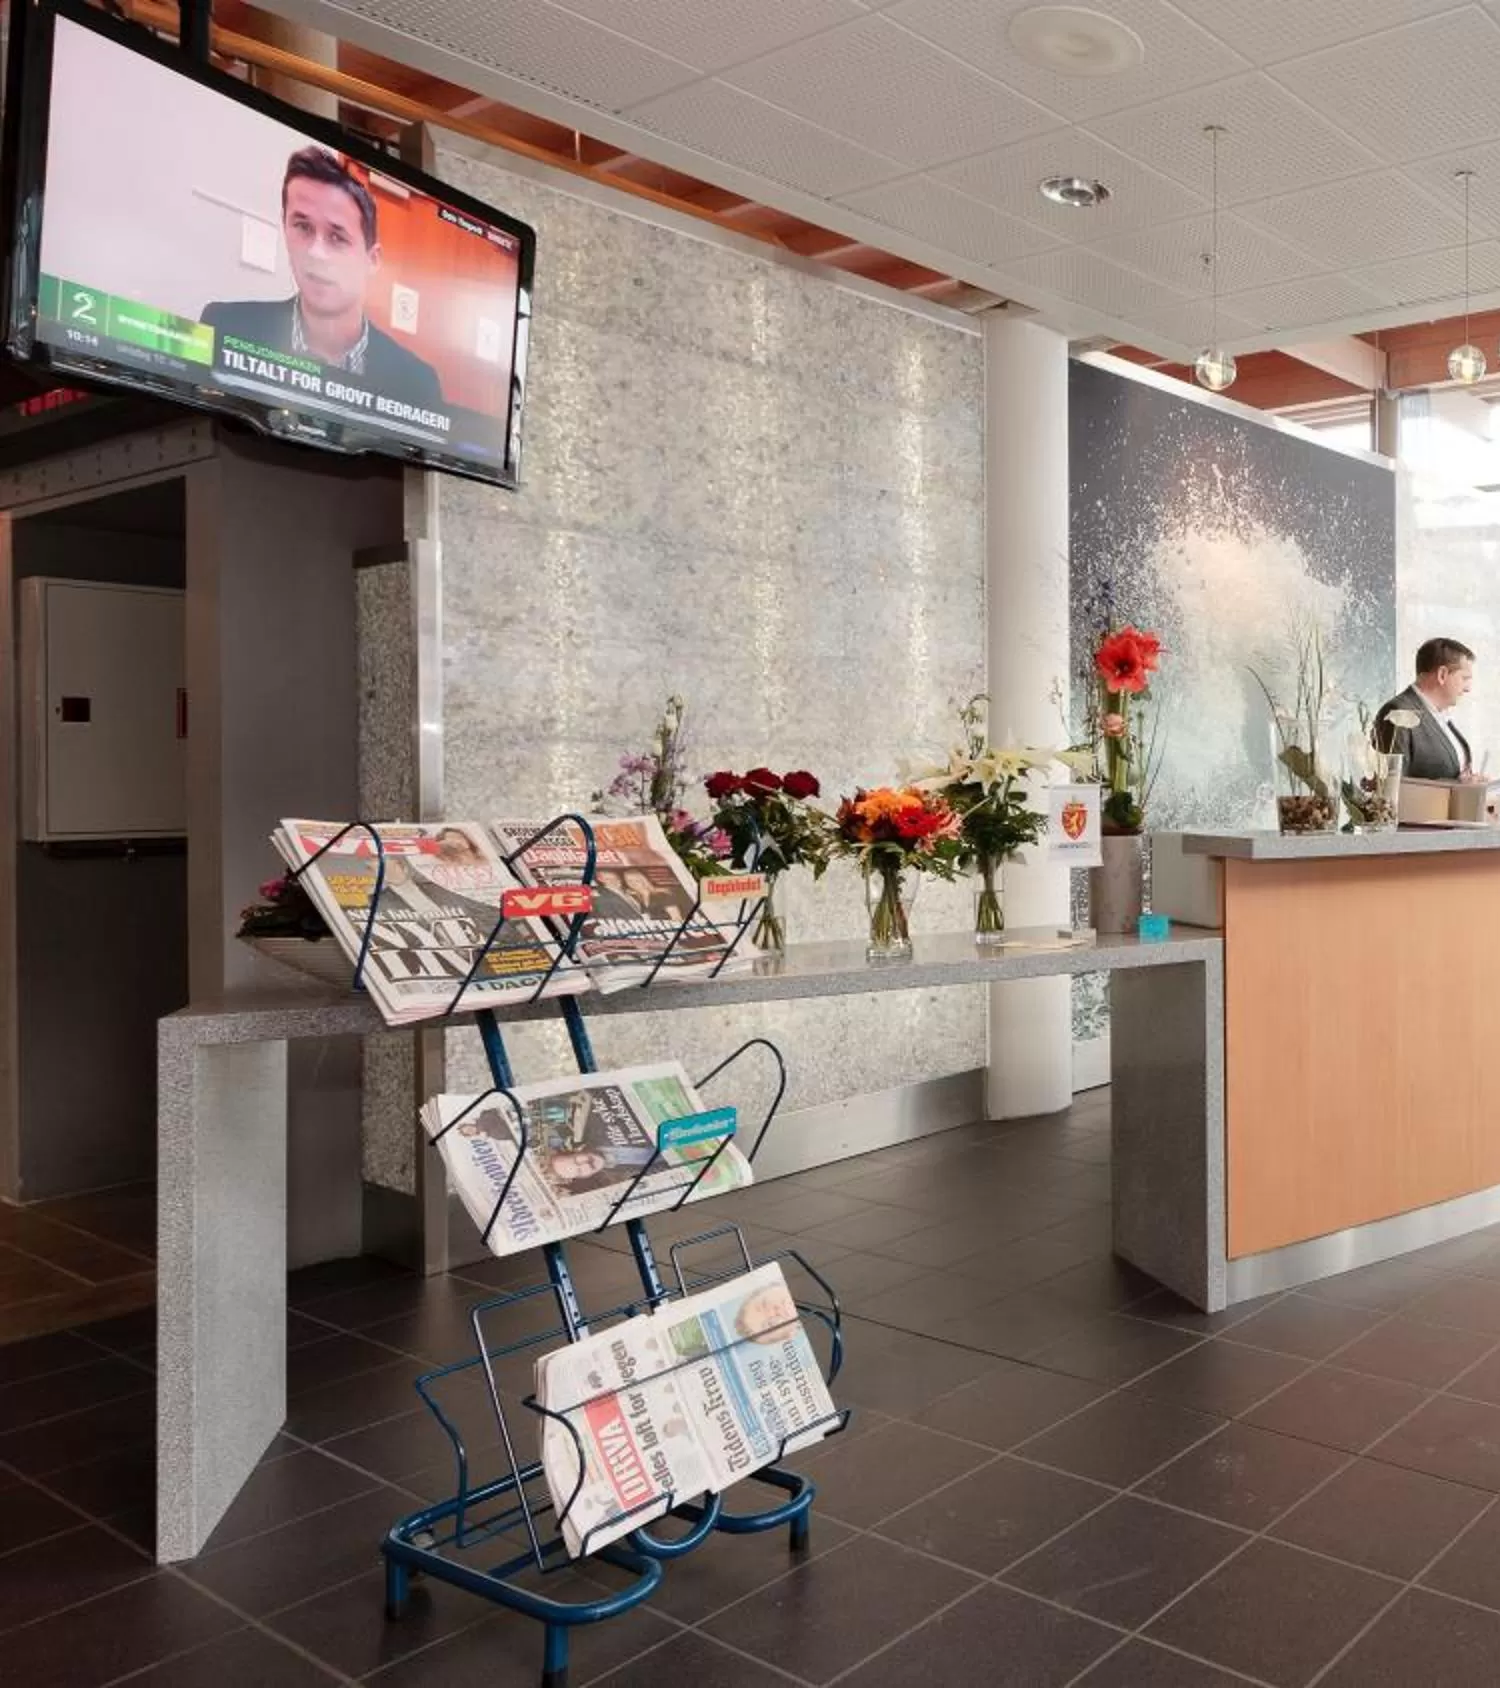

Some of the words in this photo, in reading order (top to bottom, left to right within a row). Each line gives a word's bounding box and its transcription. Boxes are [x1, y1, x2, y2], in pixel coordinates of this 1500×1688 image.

[72, 291, 97, 325] 2
[222, 349, 290, 383] TILTALT
[290, 367, 322, 393] FOR
[324, 380, 375, 408] GROVT
[375, 395, 450, 432] BEDRAGERI
[511, 890, 585, 910] VG
[352, 915, 487, 951] NYE
[716, 1409, 751, 1473] Tidens
